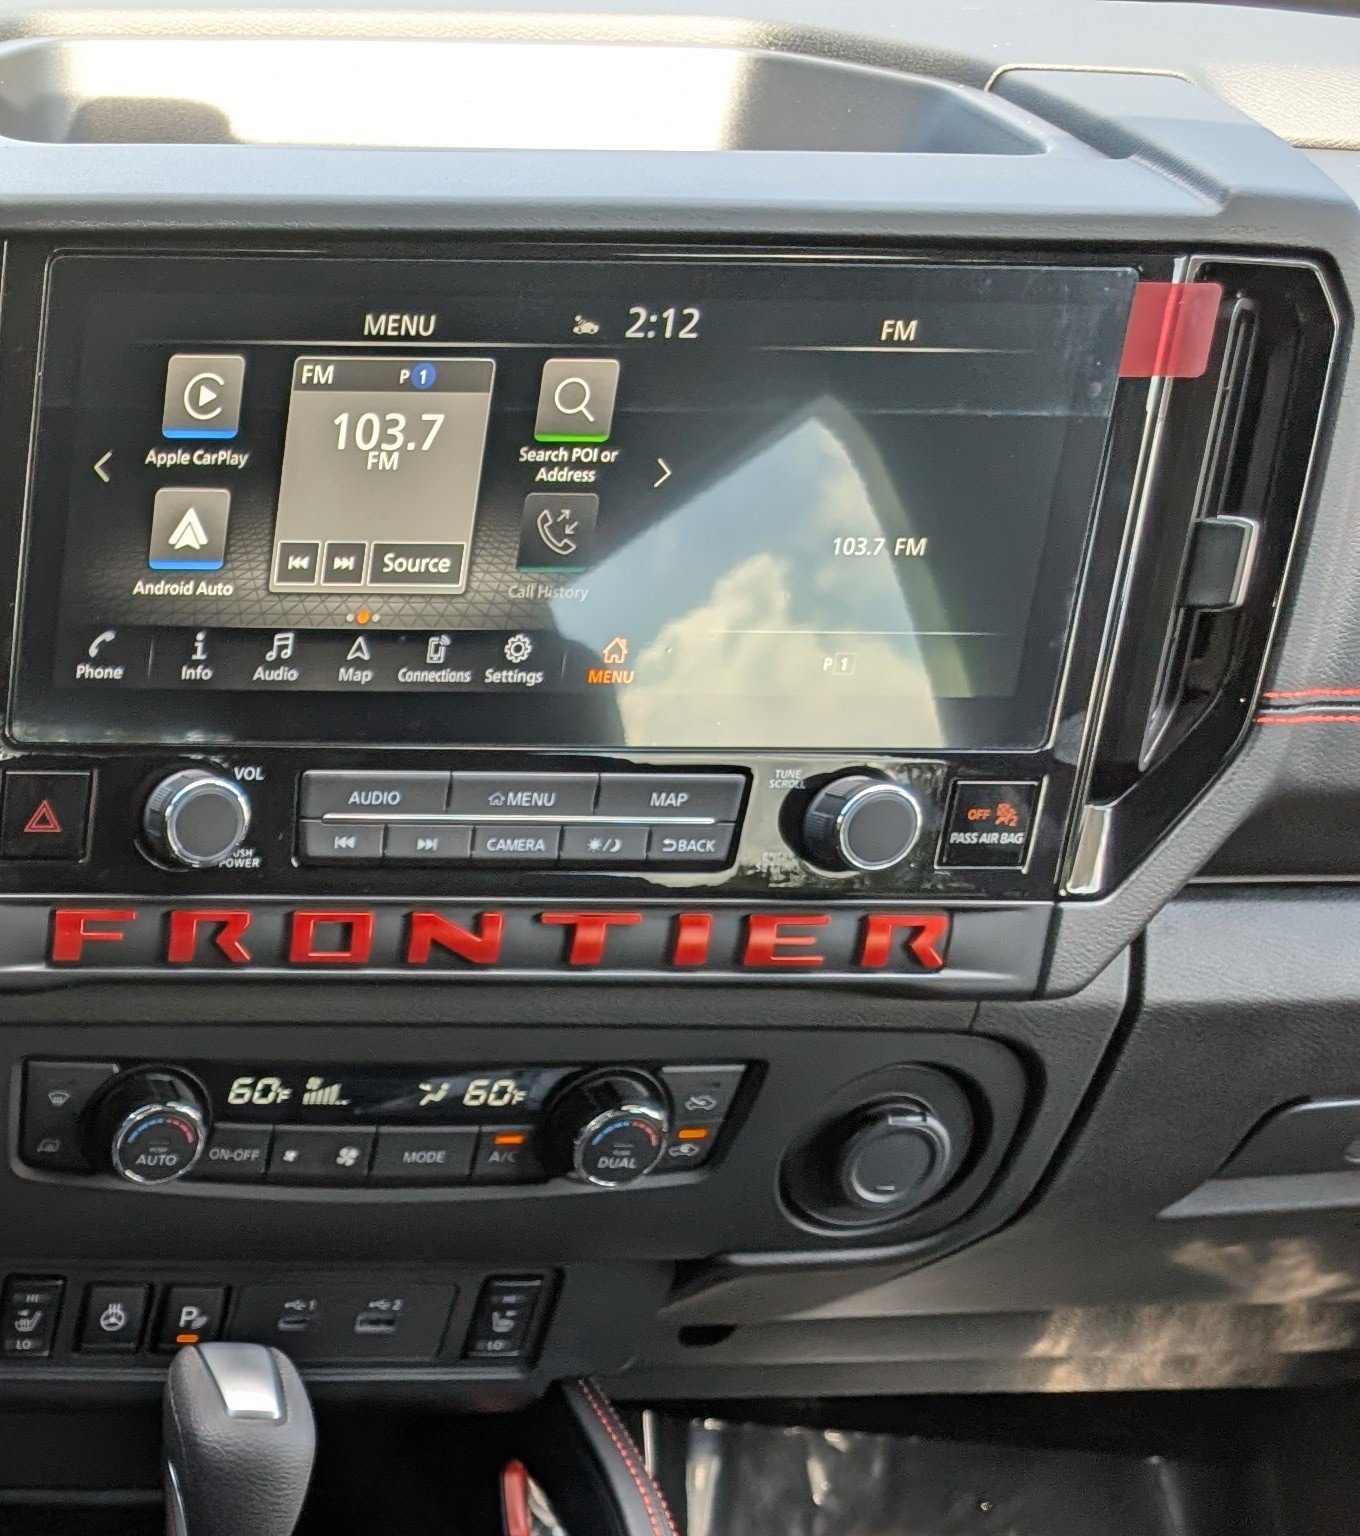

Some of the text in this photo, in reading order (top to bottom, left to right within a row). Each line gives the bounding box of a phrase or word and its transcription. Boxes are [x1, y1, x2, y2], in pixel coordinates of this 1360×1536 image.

[363, 313, 437, 337] MENU
[625, 306, 701, 339] 2:12
[880, 319, 918, 341] FM
[300, 364, 335, 385] FM
[332, 412, 445, 452] 103.7
[145, 449, 249, 469] Apple CarPlay
[366, 451, 399, 471] FM
[518, 447, 619, 463] Search POI or
[535, 466, 596, 483] Address
[832, 536, 928, 557] 103.7 FM
[382, 555, 451, 573] Source
[132, 580, 234, 596] Android Auto
[508, 585, 589, 602] Call History
[75, 665, 123, 680] Phone
[180, 665, 213, 681] Info
[253, 666, 299, 682] Audio
[338, 668, 373, 685] Map
[398, 668, 472, 683] Connections
[484, 668, 544, 687] Settings
[587, 668, 636, 685] MENU
[234, 766, 266, 782] VOL
[774, 768, 803, 780] TUNE
[768, 778, 806, 790] SCROLL
[348, 790, 402, 806] AUDIO
[506, 791, 556, 807] MENU
[649, 792, 689, 807] MAP
[967, 808, 992, 821] OFF
[486, 838, 546, 851] CAMERA
[677, 839, 716, 852] BACK
[950, 832, 1025, 845] PASS AIR BAG
[51, 908, 951, 969] FRONTIER
[134, 1153, 178, 1167] AUTO
[208, 1147, 261, 1162] ON-OFF
[402, 1150, 447, 1164] MODE
[487, 1150, 517, 1164] A/C
[596, 1156, 638, 1170] DUAL
